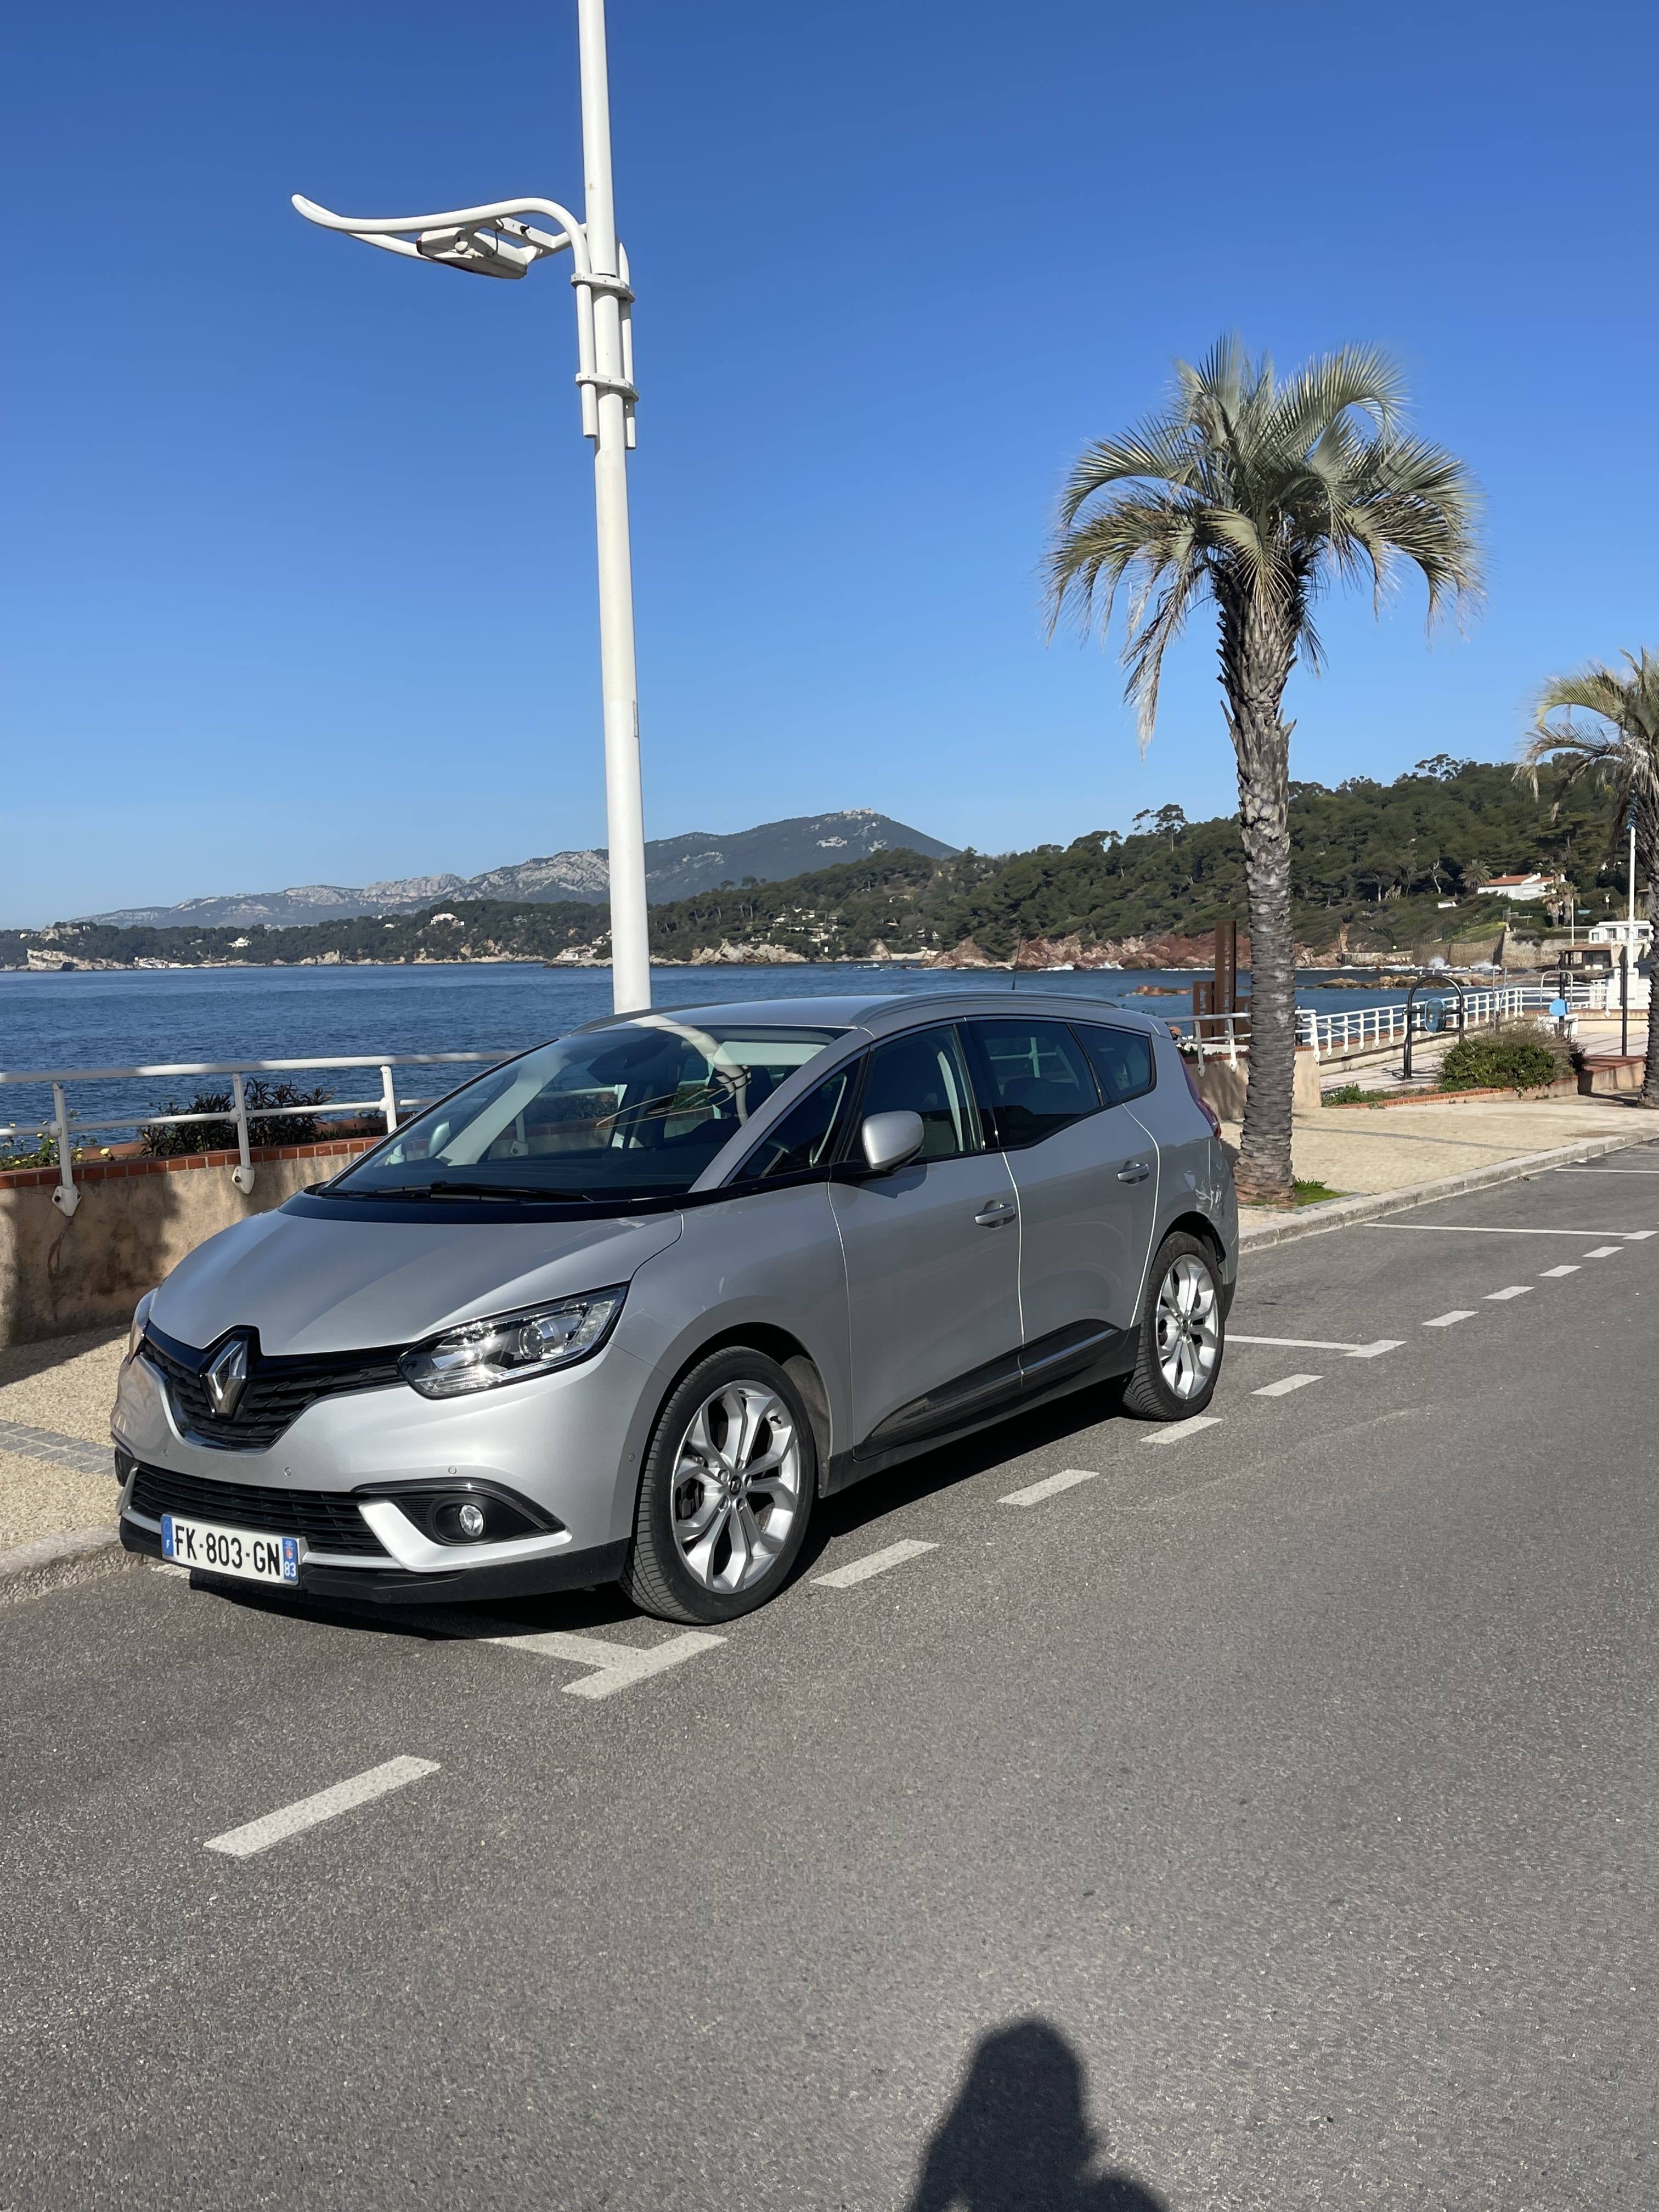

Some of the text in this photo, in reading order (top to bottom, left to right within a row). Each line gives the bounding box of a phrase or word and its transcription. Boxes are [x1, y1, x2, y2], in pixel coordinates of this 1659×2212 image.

[166, 1539, 170, 1549] F
[174, 1525, 280, 1576] FK-803-GN
[284, 1561, 296, 1577] 83
